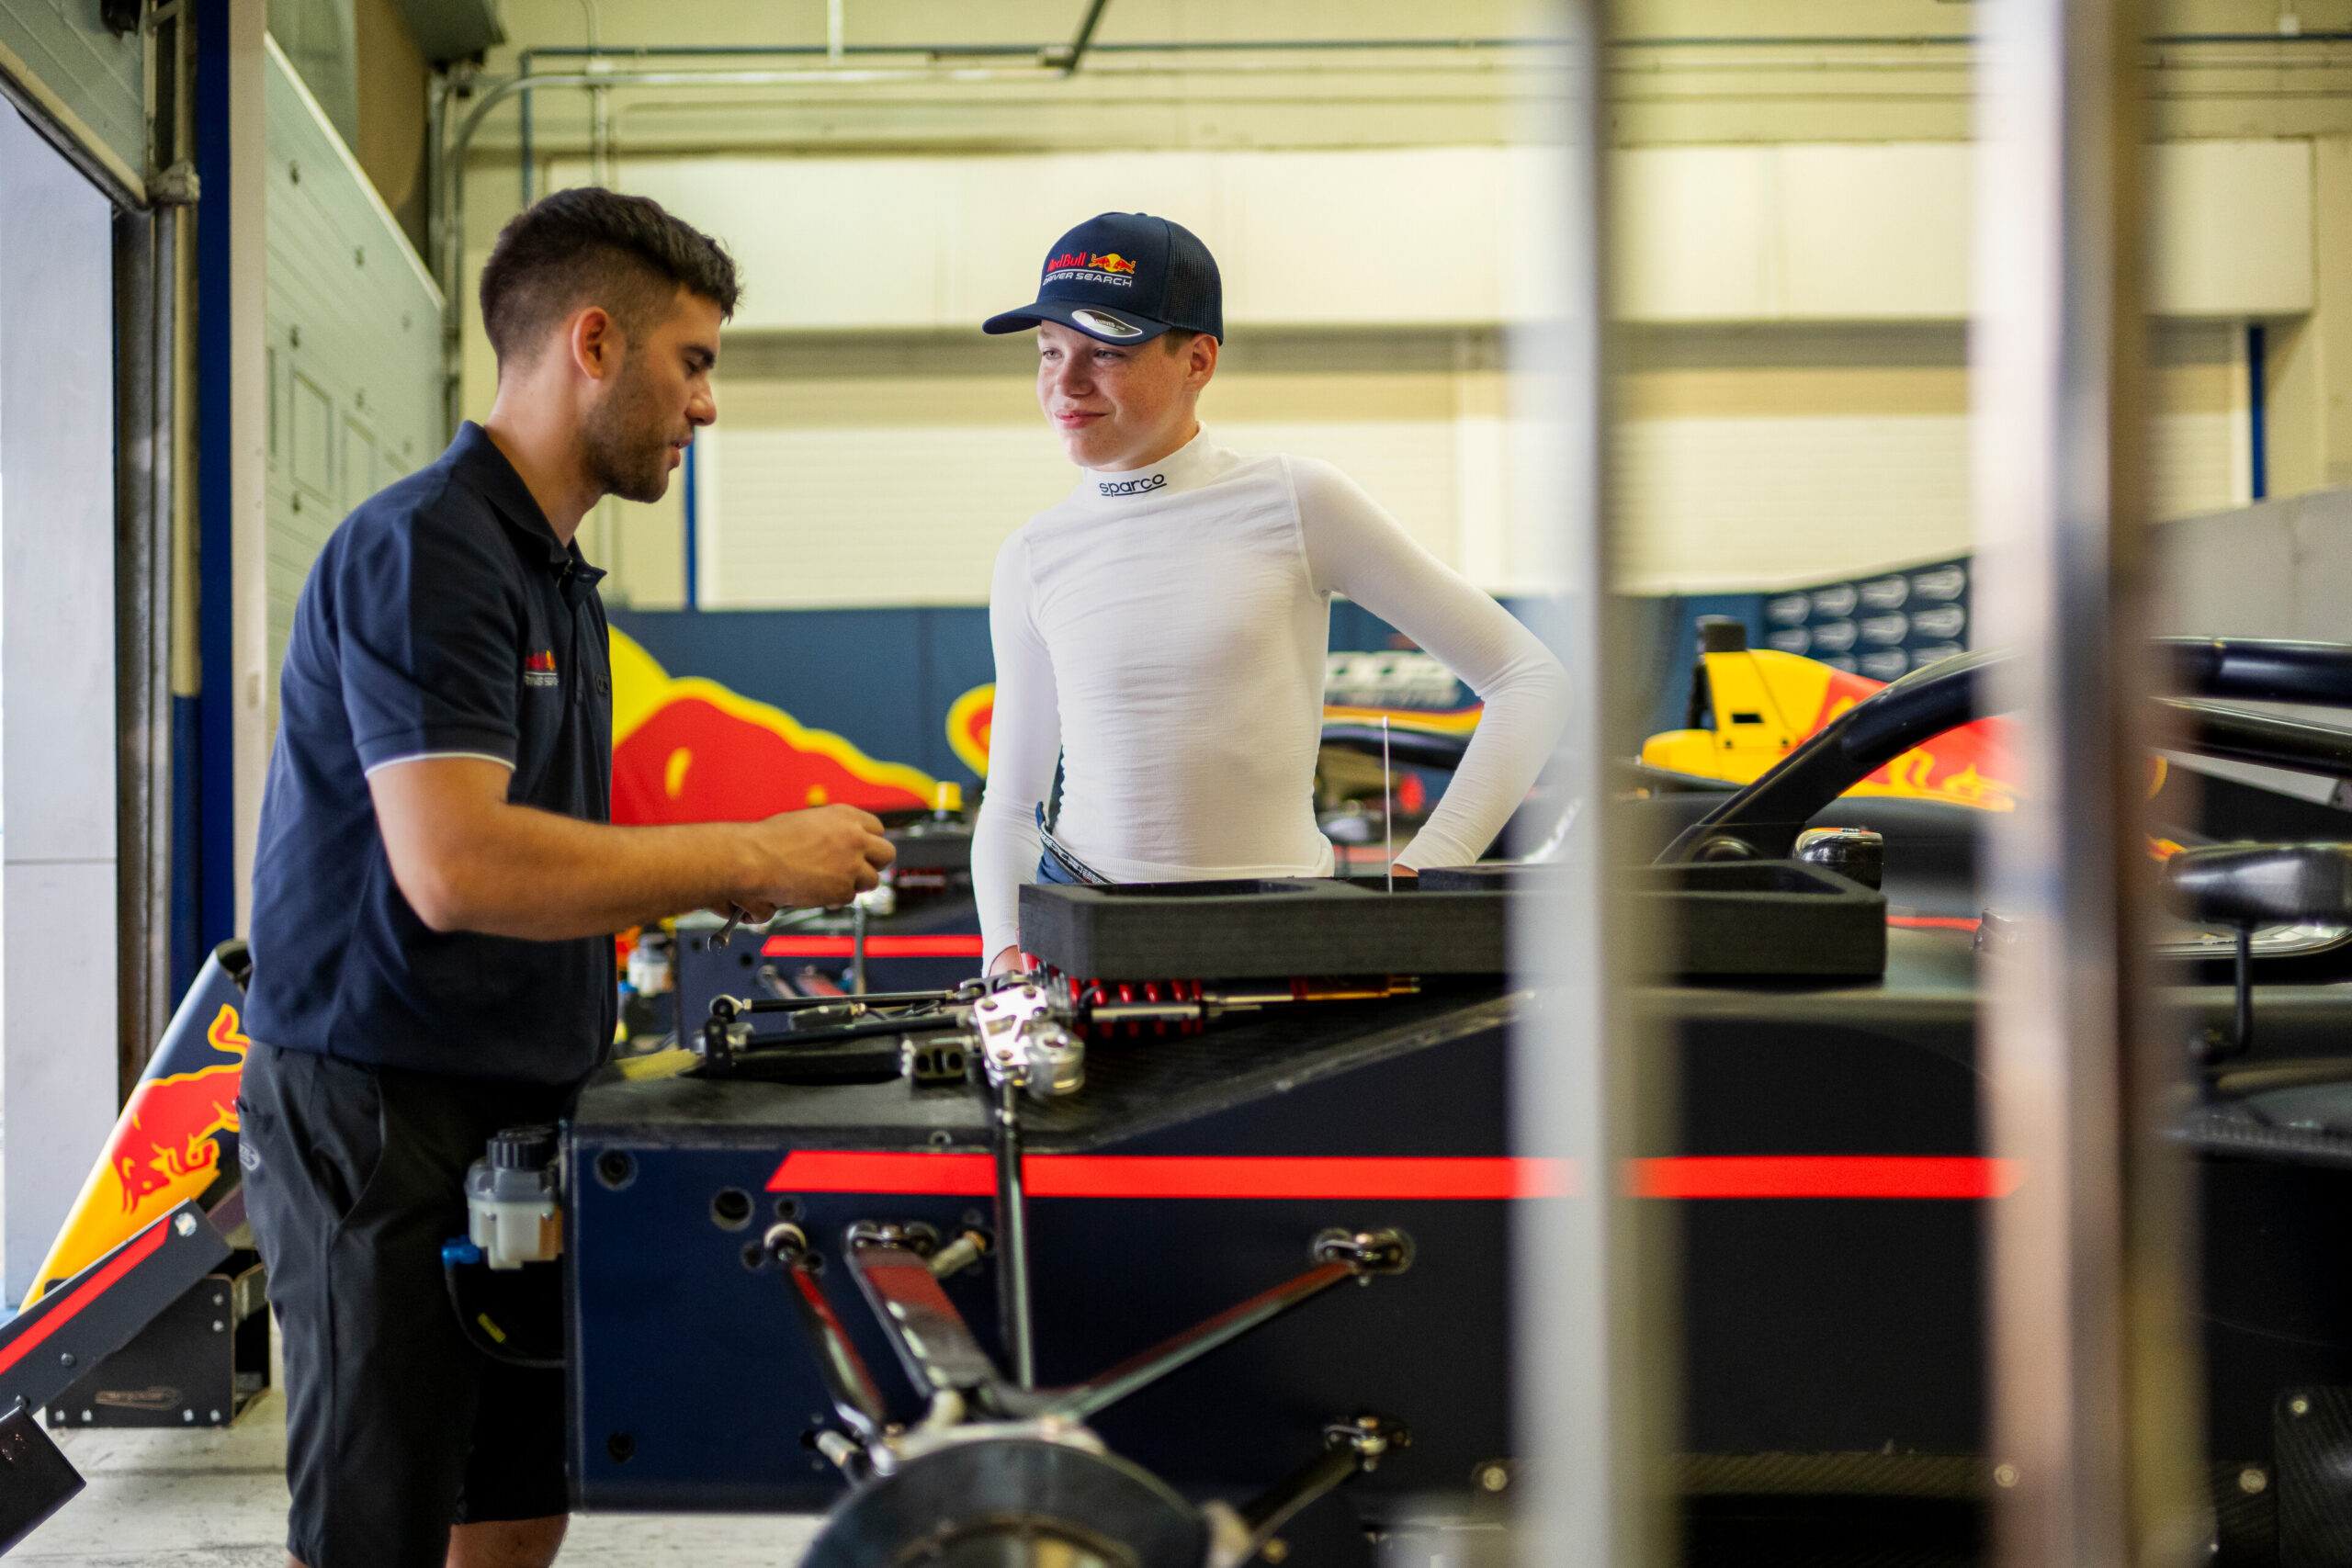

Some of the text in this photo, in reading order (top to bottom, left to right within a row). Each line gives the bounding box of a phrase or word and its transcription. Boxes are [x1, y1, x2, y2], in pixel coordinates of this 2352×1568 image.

[1043, 272, 1133, 288] DRIVER SEARCH
[1099, 473, 1165, 497] sparco
